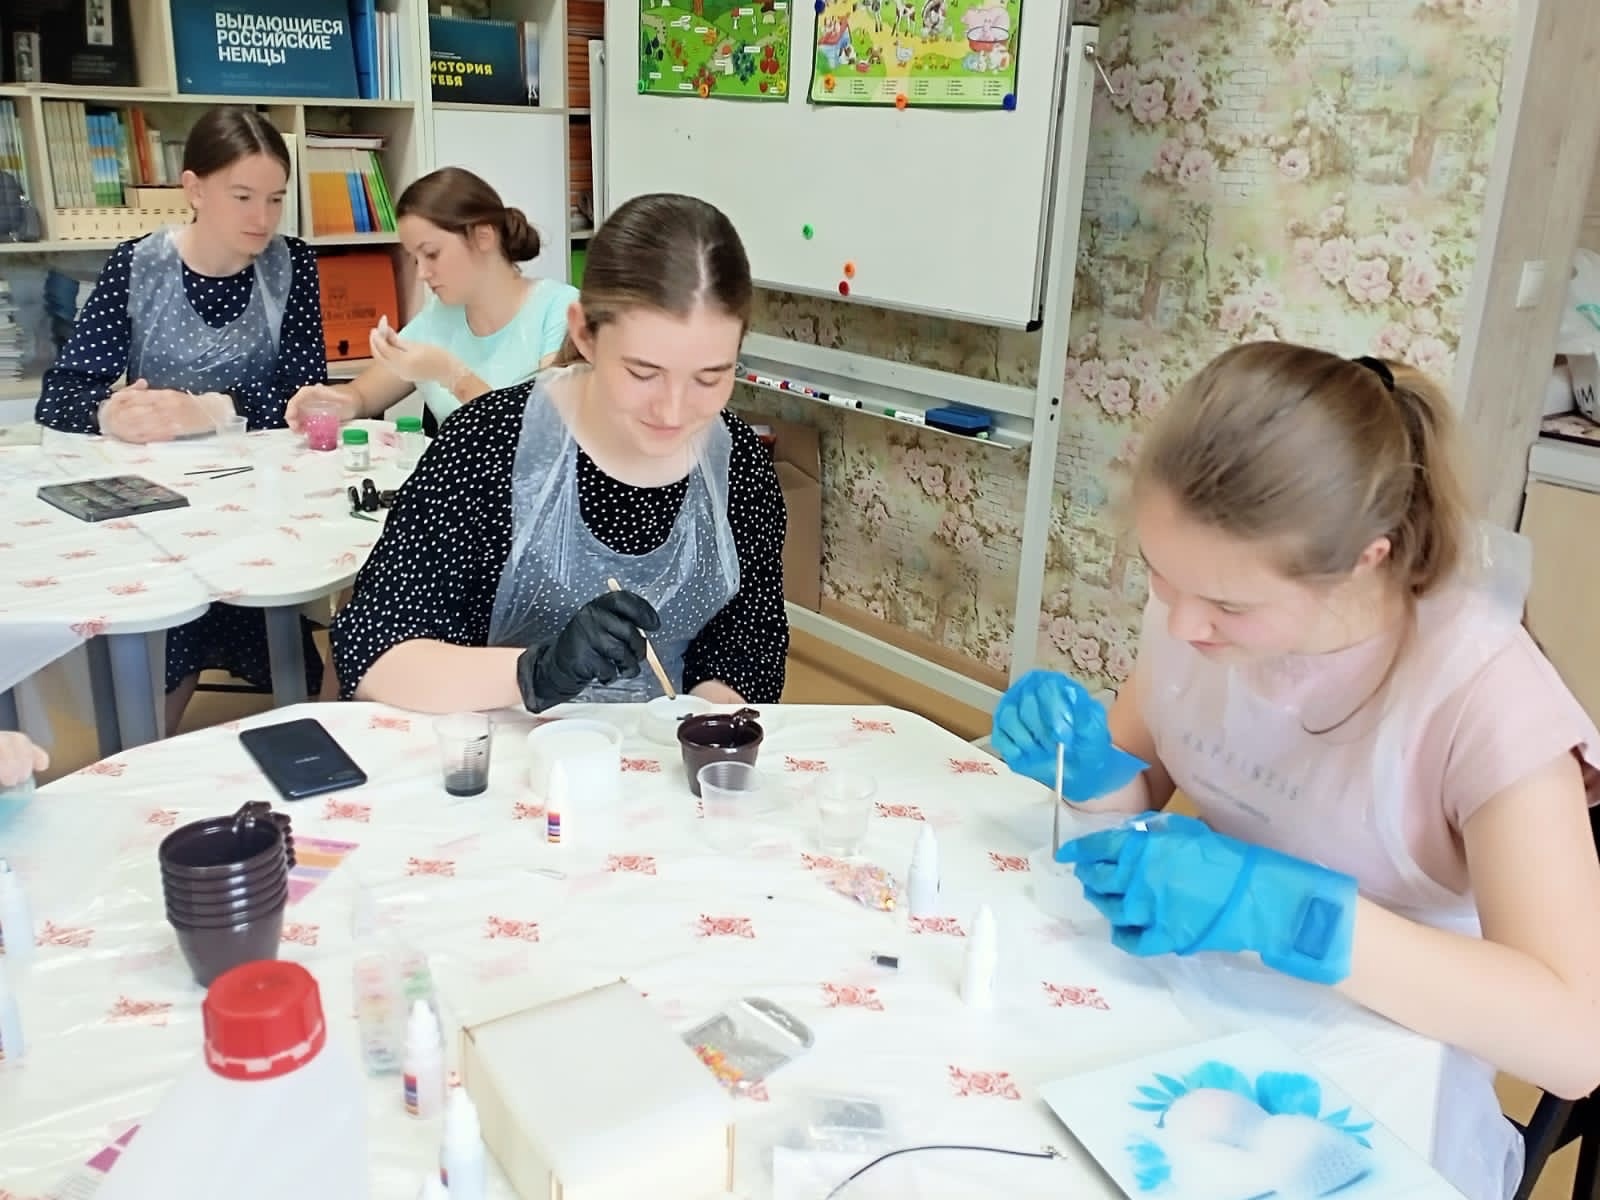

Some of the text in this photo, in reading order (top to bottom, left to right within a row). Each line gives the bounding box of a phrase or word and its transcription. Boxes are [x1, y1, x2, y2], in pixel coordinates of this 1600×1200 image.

[215, 12, 343, 35] ВЫДАЮЩИЕСЯ
[216, 29, 332, 50] РОССИЙСКИЕ
[218, 46, 286, 67] НЕМЦЫ
[431, 74, 463, 86] ТЕБЯ
